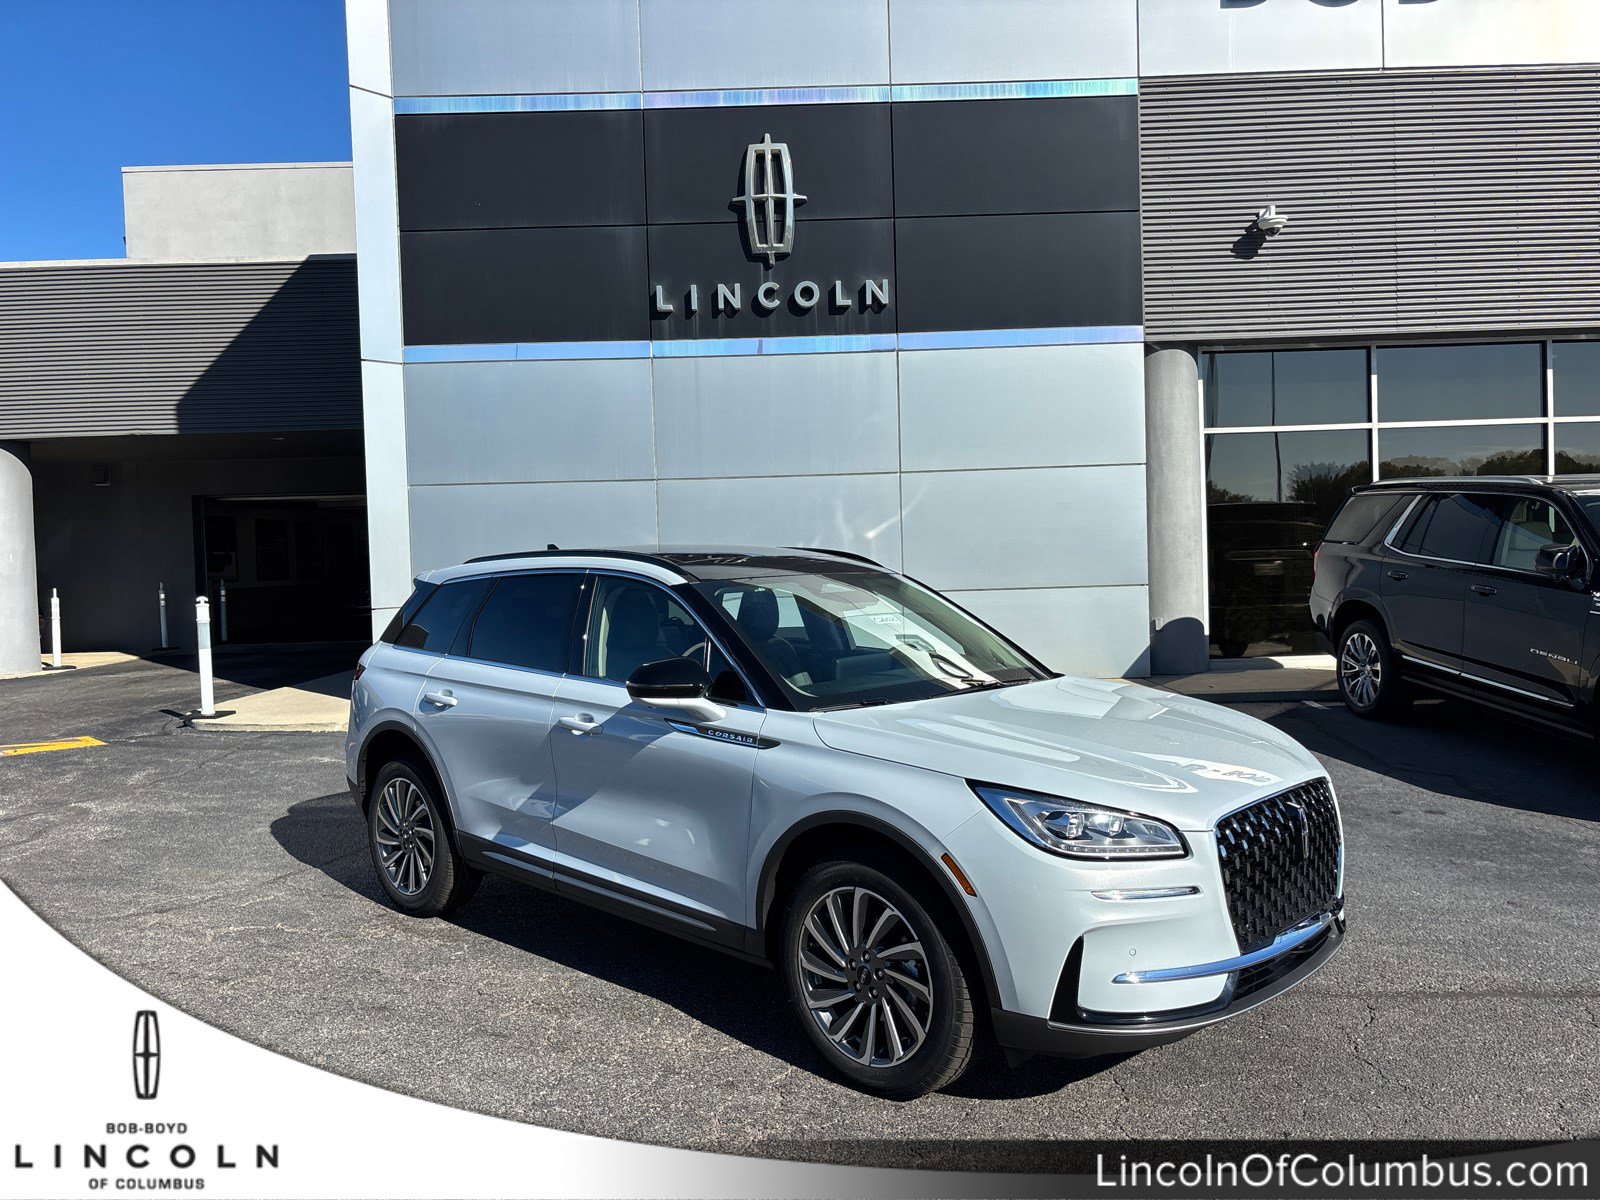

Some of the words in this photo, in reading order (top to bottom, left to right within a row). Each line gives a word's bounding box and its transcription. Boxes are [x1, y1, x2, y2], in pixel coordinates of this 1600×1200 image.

[656, 279, 889, 312] LINCOLN
[1530, 648, 1578, 665] DENALI
[707, 729, 753, 743] CORSAIR
